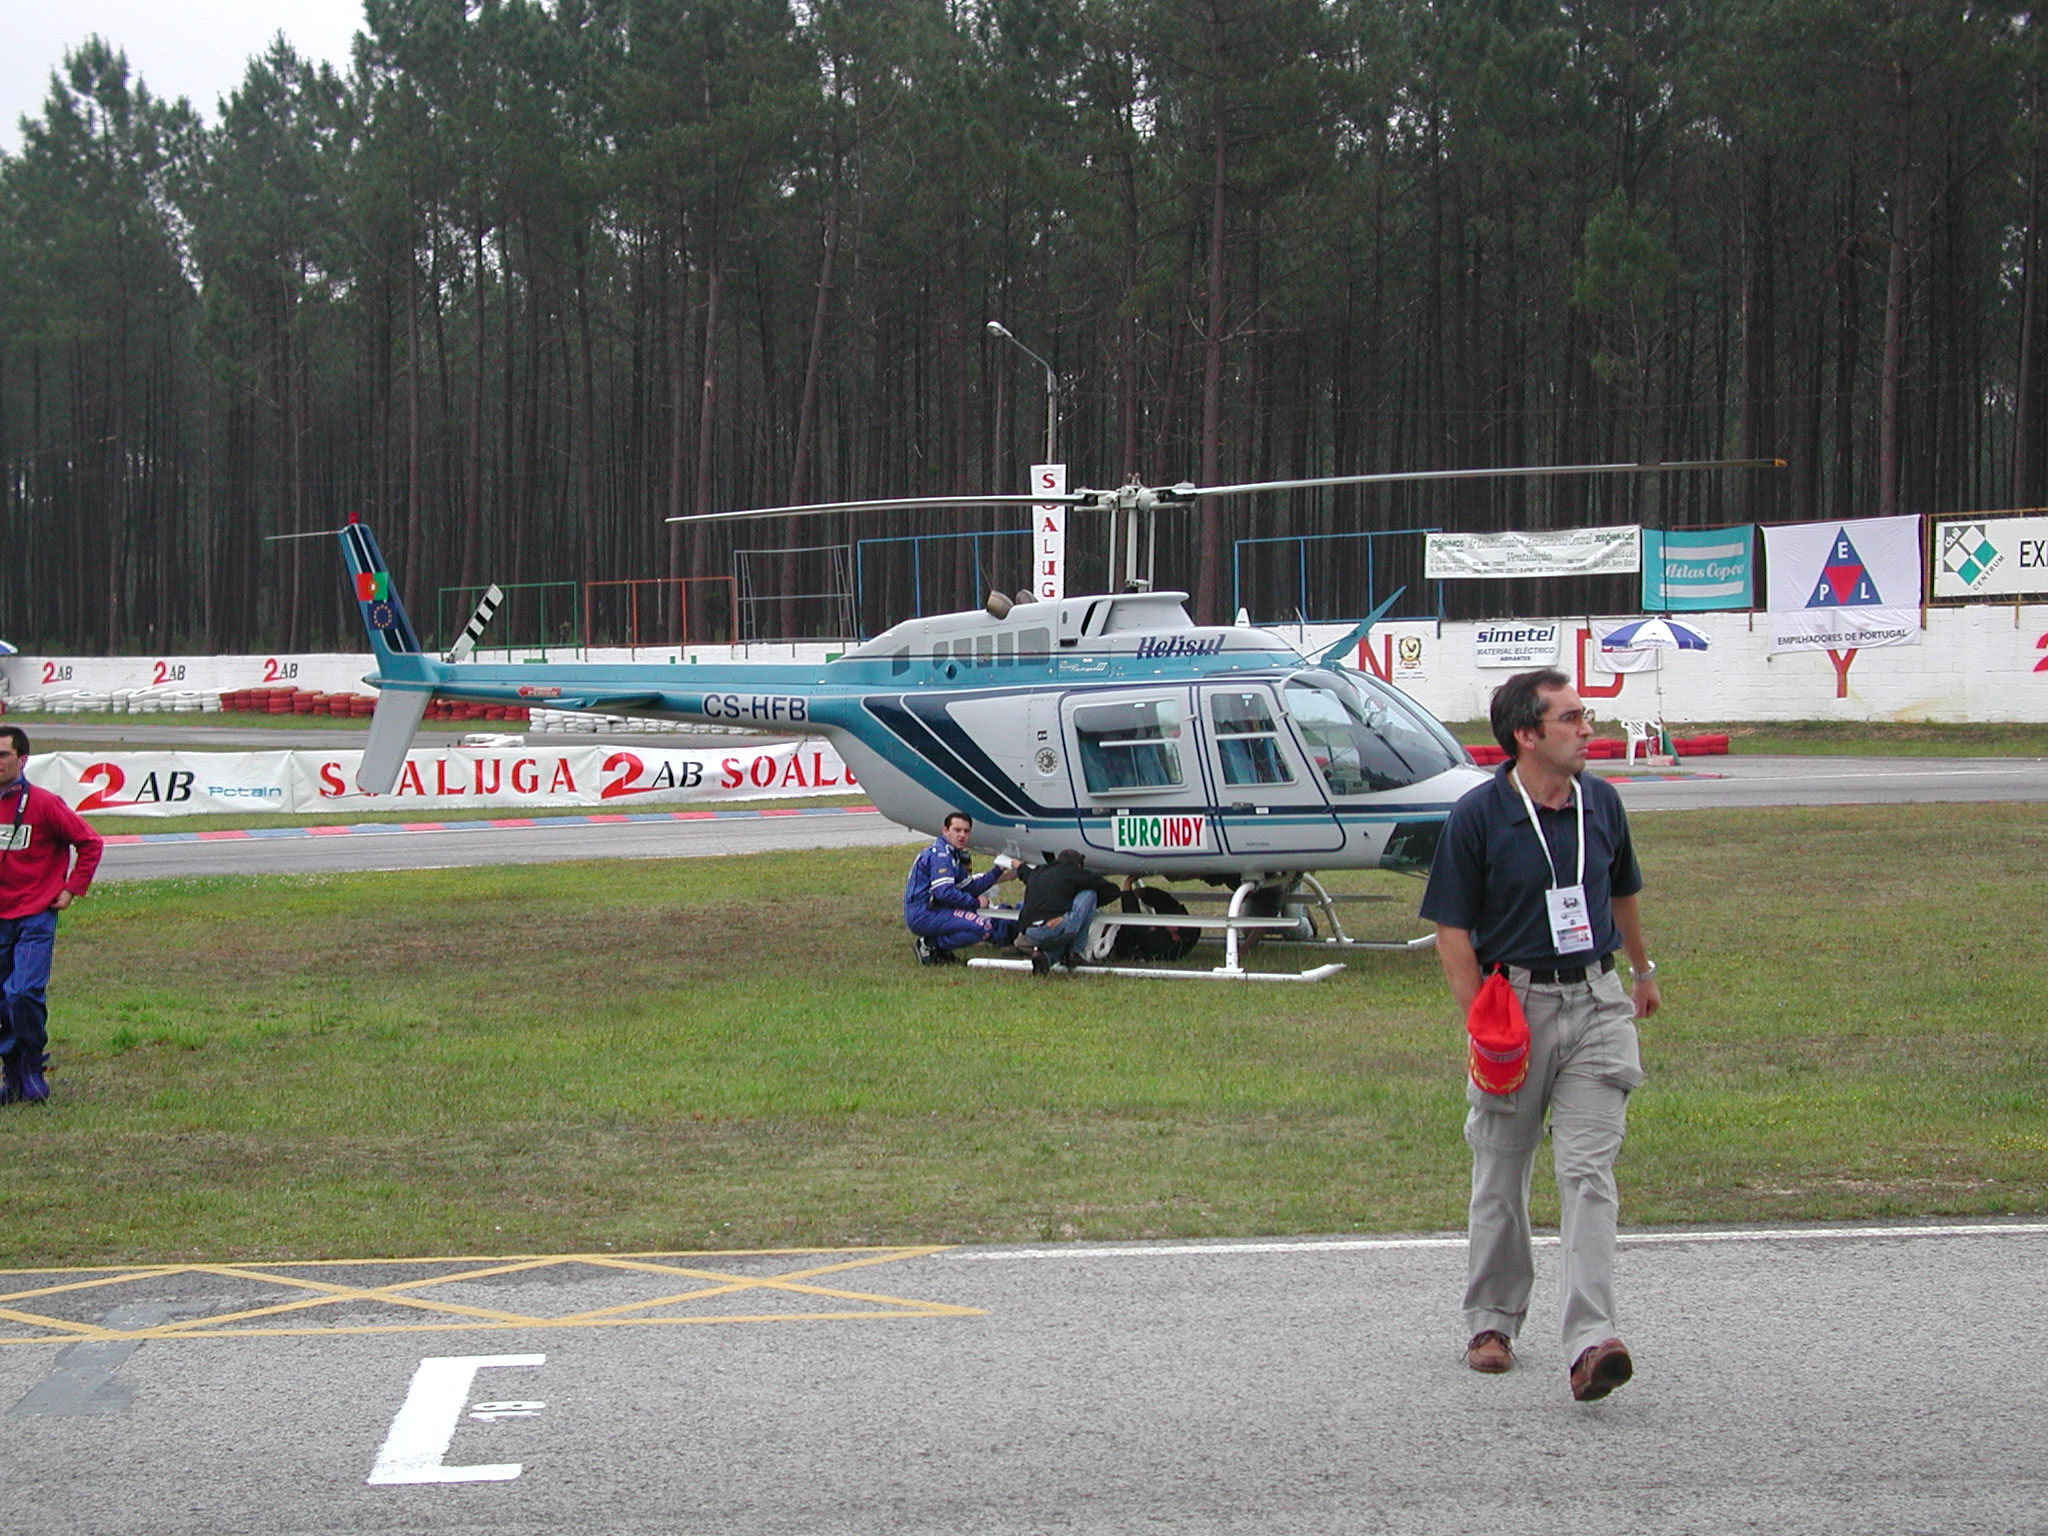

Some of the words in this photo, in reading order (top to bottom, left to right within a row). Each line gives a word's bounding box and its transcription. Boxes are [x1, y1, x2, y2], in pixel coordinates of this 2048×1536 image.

[1041, 472, 1058, 598] SALUG
[1837, 541, 1849, 560] E
[2020, 540, 2048, 568] EX
[1972, 554, 2005, 591] CENTRUM
[1819, 583, 1830, 600] P
[1860, 581, 1870, 599] L
[1136, 634, 1227, 660] Helisul
[1476, 626, 1556, 643] simetel
[1778, 633, 1843, 646] EMPILHADORES
[1844, 632, 1857, 641] DE
[1860, 629, 1909, 640] PORTUGAL
[1477, 647, 1513, 656] MATERIAL
[703, 693, 807, 721] CS-HFB
[208, 786, 282, 797] Potain
[319, 758, 577, 799] SALUGA
[1119, 817, 1204, 847] EUROINDY
